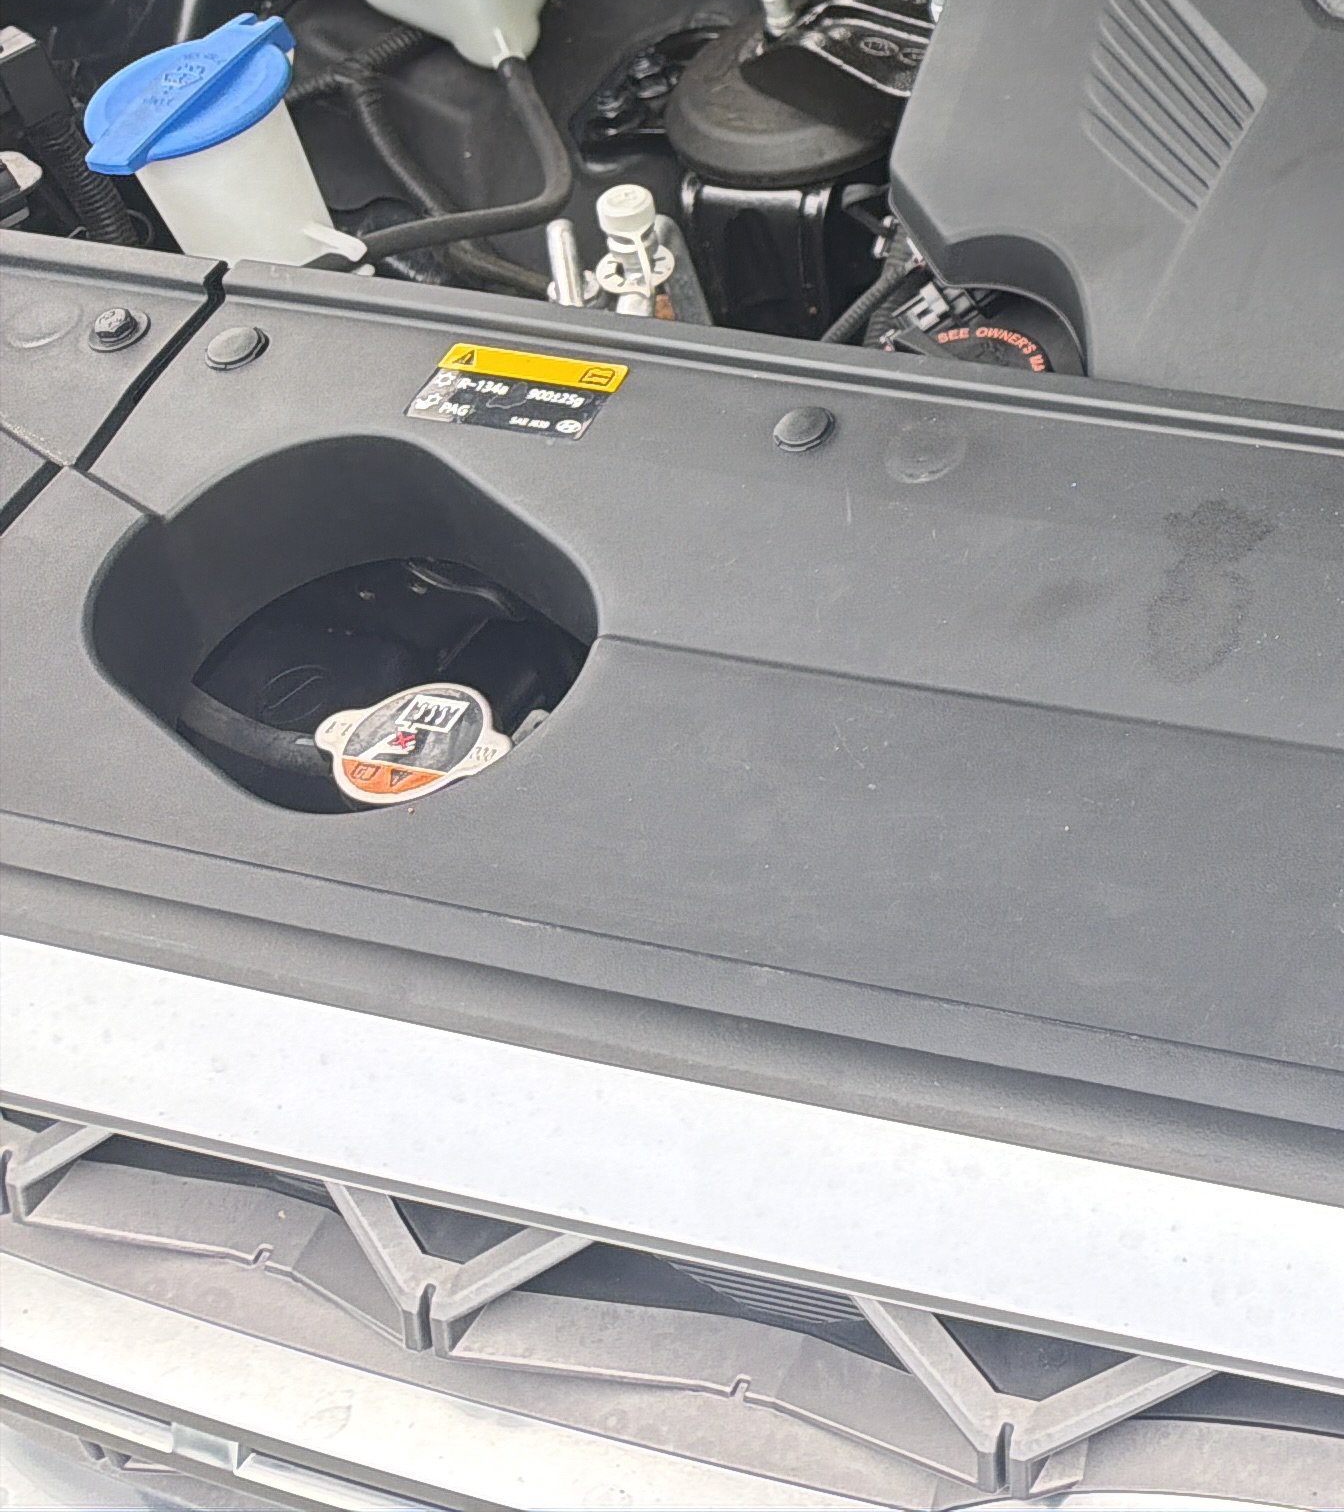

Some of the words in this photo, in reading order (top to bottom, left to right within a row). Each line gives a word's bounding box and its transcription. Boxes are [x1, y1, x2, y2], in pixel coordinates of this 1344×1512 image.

[937, 327, 970, 344] SEE
[974, 326, 1038, 355] OWNER'S
[458, 376, 510, 396] R-134a
[438, 400, 470, 417] PAG
